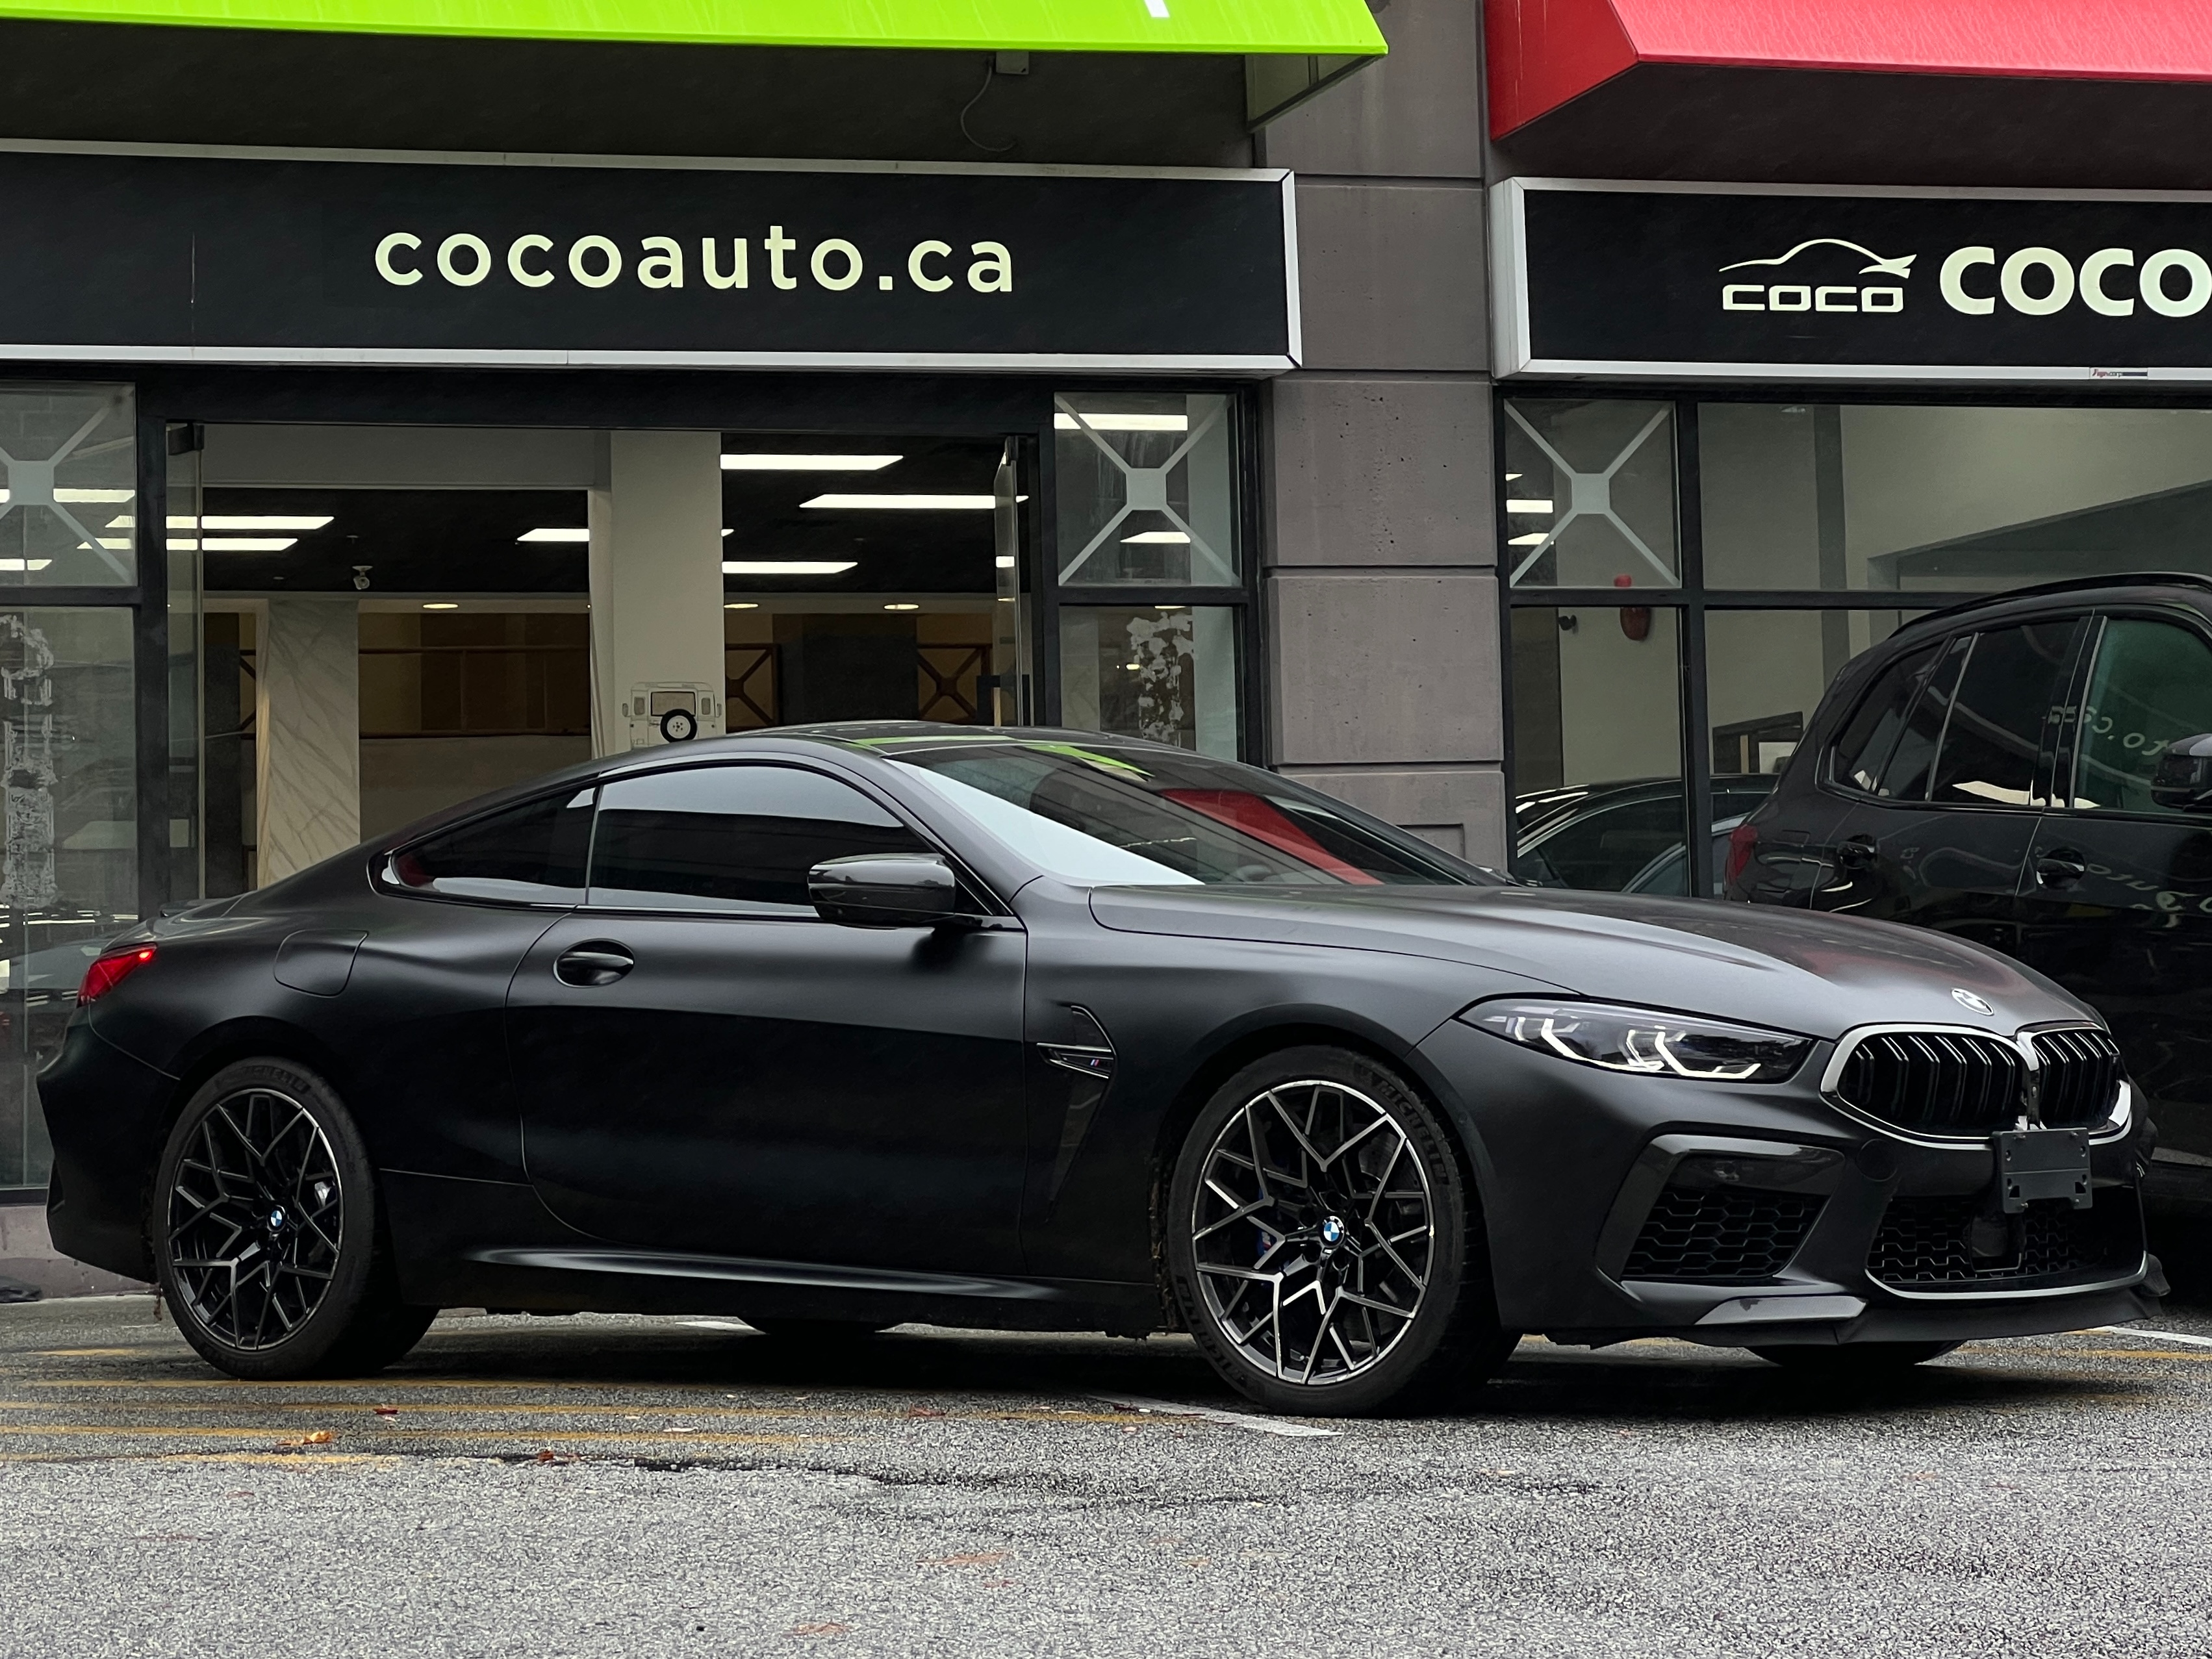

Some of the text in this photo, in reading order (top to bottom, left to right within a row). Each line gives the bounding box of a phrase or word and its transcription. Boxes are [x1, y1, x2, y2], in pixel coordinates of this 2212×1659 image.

[375, 225, 1012, 293] cocoauto.ca
[1939, 246, 2212, 317] COCO
[1722, 284, 1904, 312] COCO
